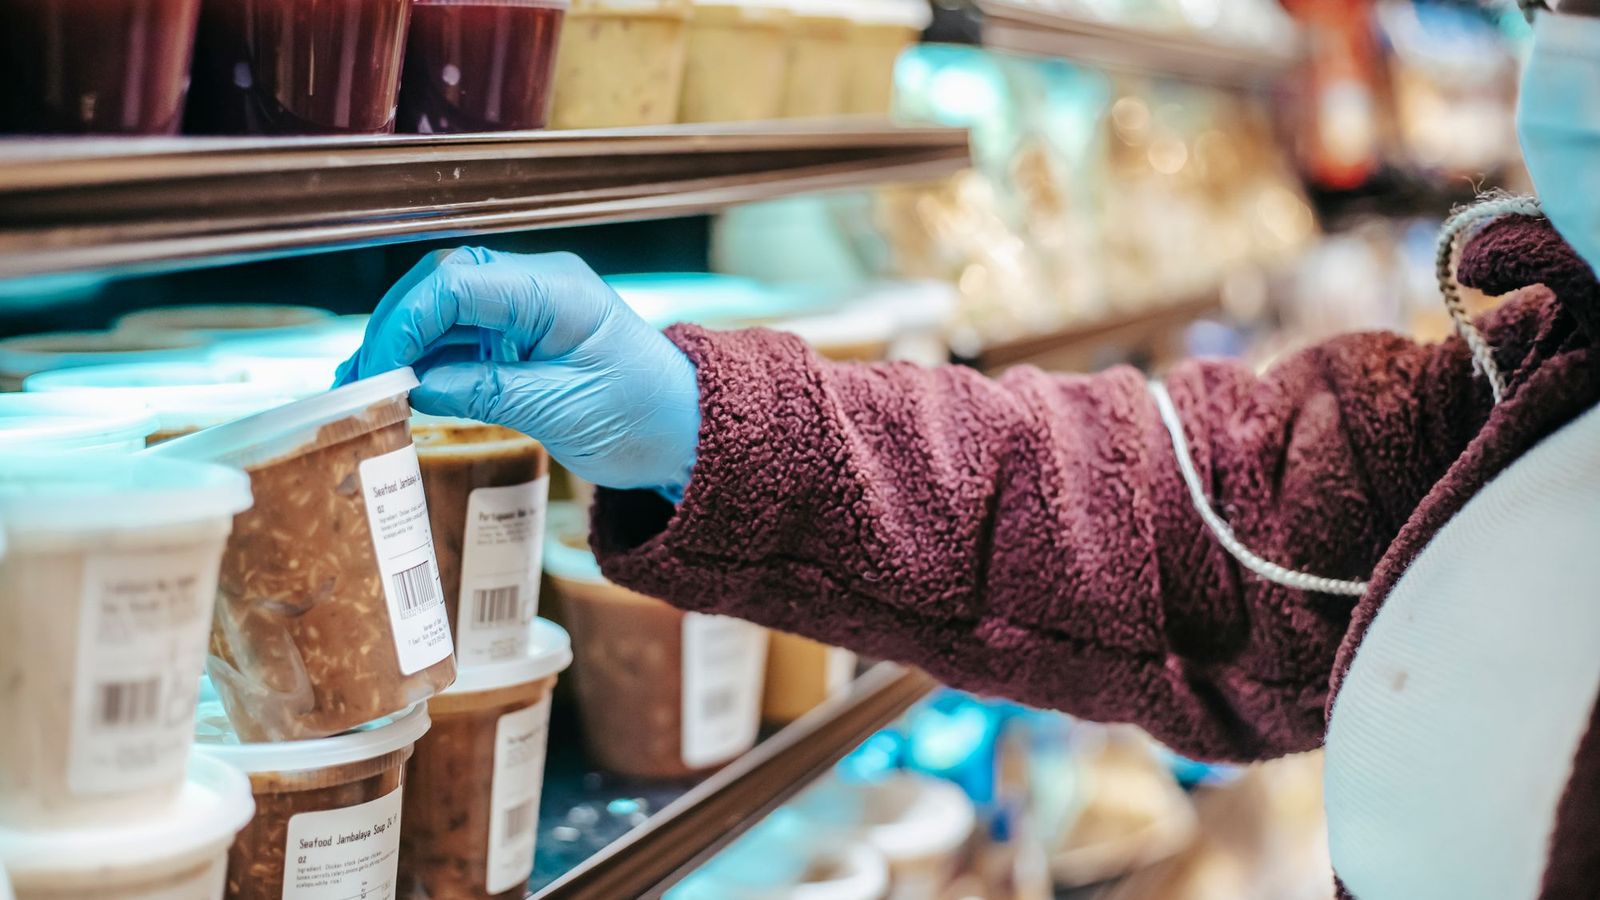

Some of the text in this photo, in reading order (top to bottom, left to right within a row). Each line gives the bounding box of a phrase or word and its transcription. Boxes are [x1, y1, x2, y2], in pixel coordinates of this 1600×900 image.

[373, 481, 398, 498] Seafood
[299, 836, 332, 849] Seafood
[336, 830, 371, 845] Jambalaya
[373, 824, 386, 835] Soup
